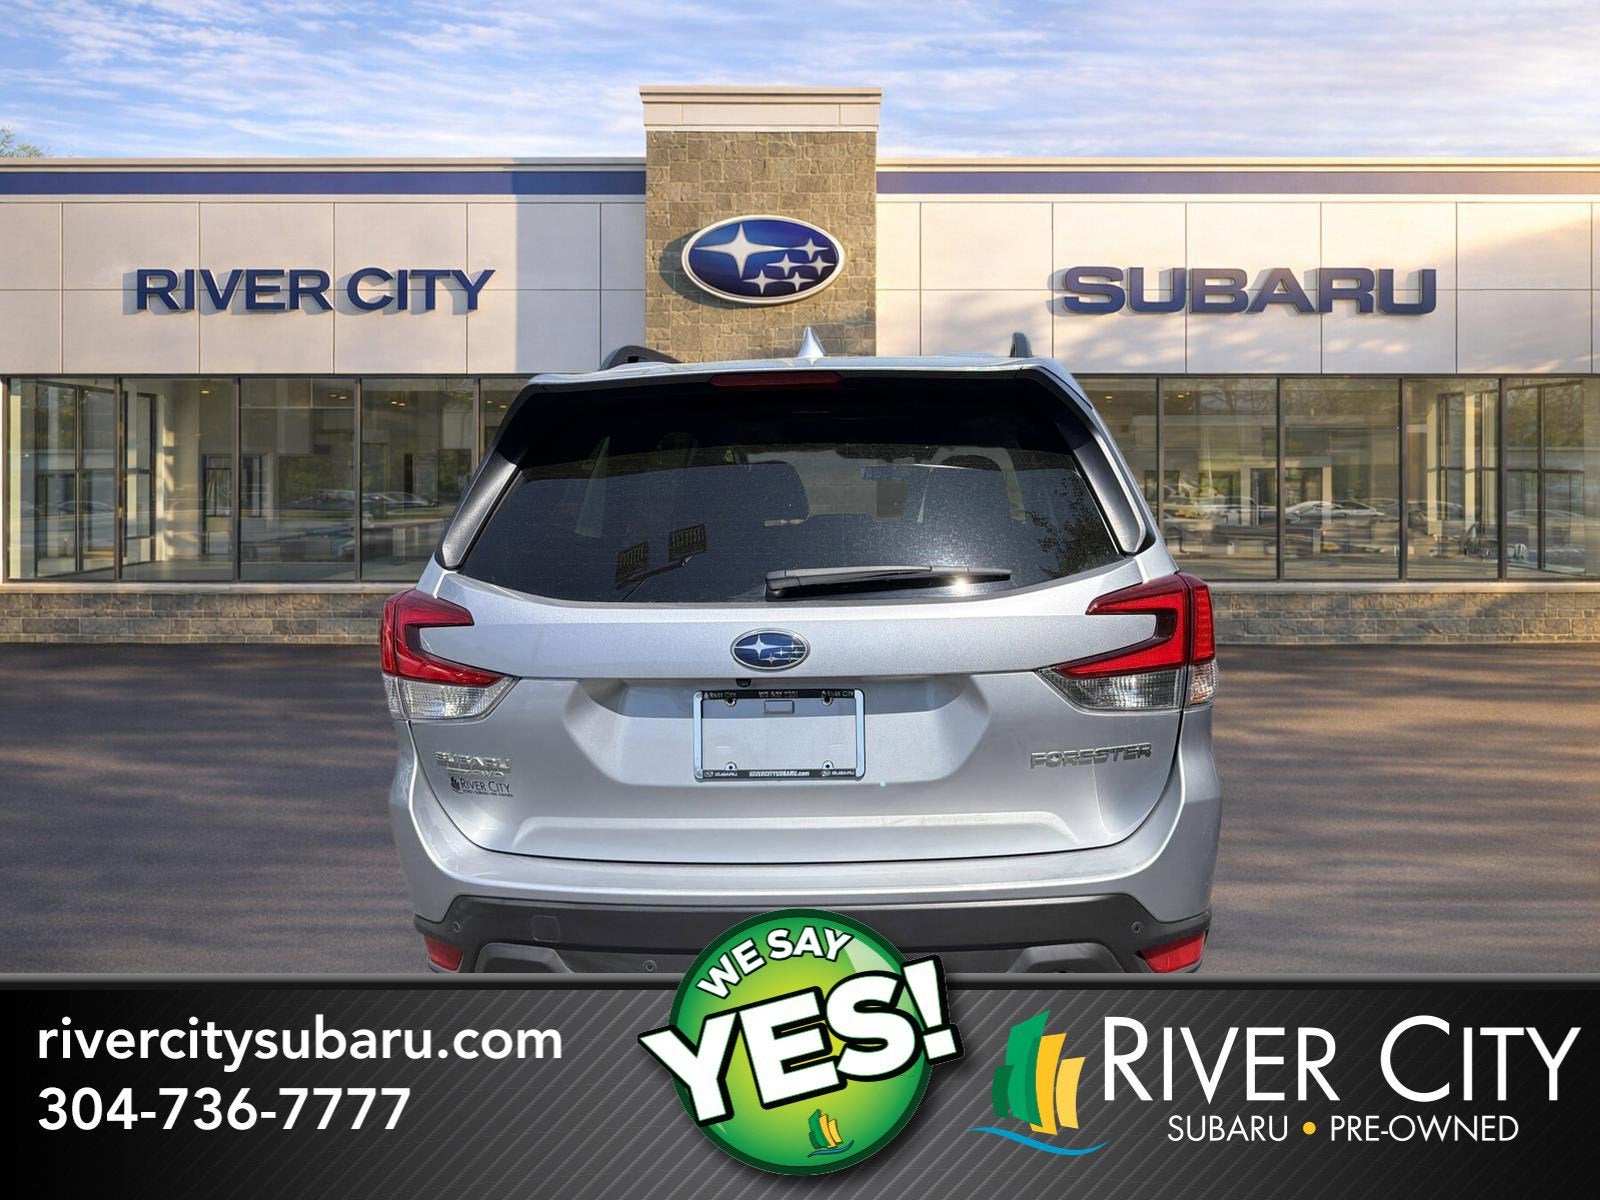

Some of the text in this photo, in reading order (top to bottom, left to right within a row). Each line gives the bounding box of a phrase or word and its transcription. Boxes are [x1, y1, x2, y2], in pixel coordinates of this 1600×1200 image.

[136, 267, 496, 311] RIVER CITY
[1062, 266, 1437, 315] SUBARU
[433, 752, 511, 770] SUBARU
[1030, 742, 1152, 768] FORESTER
[460, 778, 486, 791] RIVER
[487, 781, 511, 793] CITY
